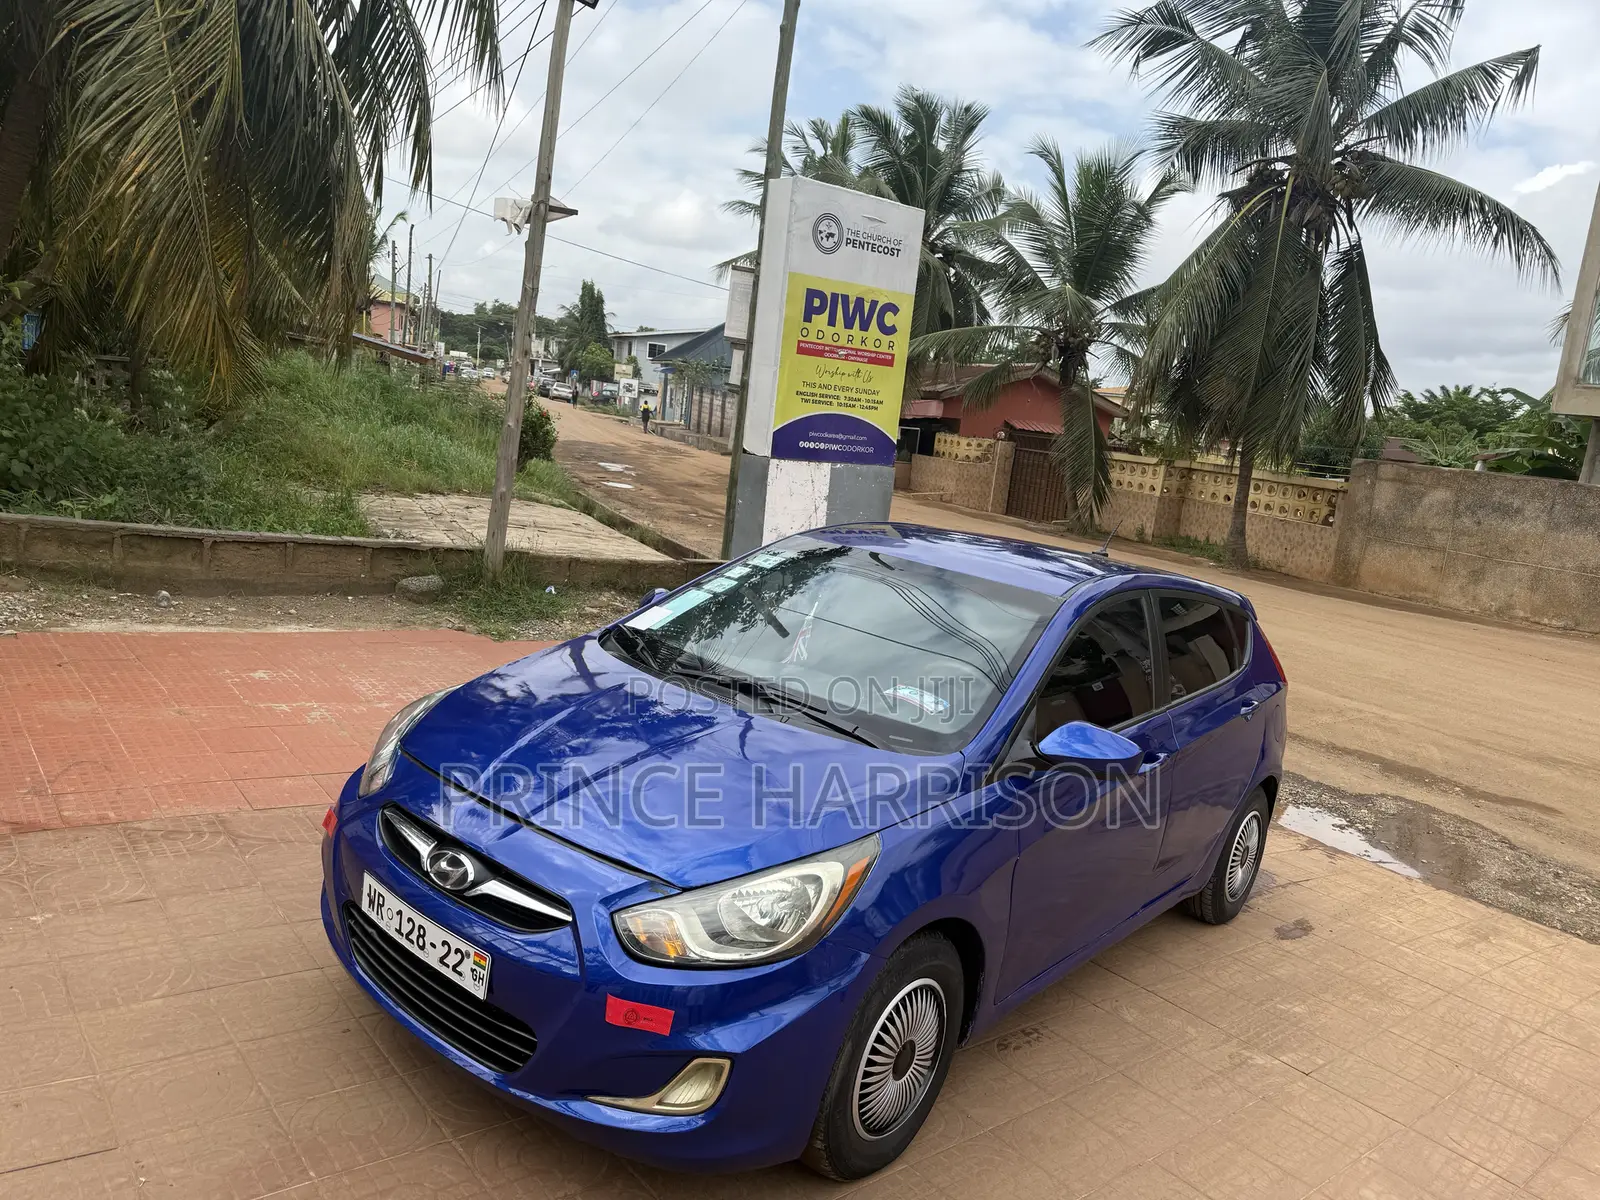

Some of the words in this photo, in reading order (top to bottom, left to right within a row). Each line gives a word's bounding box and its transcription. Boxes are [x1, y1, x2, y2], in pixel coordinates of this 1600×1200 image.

[846, 228, 860, 238] THE
[862, 231, 892, 244] CHURCH
[893, 238, 903, 246] OF
[845, 237, 902, 257] PENTECOST
[803, 288, 900, 336] PIWC
[799, 342, 825, 350] PENTECOST
[800, 327, 895, 351] ODORKOR
[796, 390, 818, 398] ENGLISH
[819, 392, 841, 400] SERVICE:
[802, 381, 817, 389] THIS
[817, 383, 833, 391] AND
[834, 385, 854, 393] EVERY
[855, 387, 880, 396] SUNDAY
[812, 399, 834, 407] SERVICE:
[825, 443, 874, 454] PIWCODORKOR
[367, 883, 385, 921] WR
[394, 908, 466, 978] 128-22
[471, 966, 485, 987] GH
